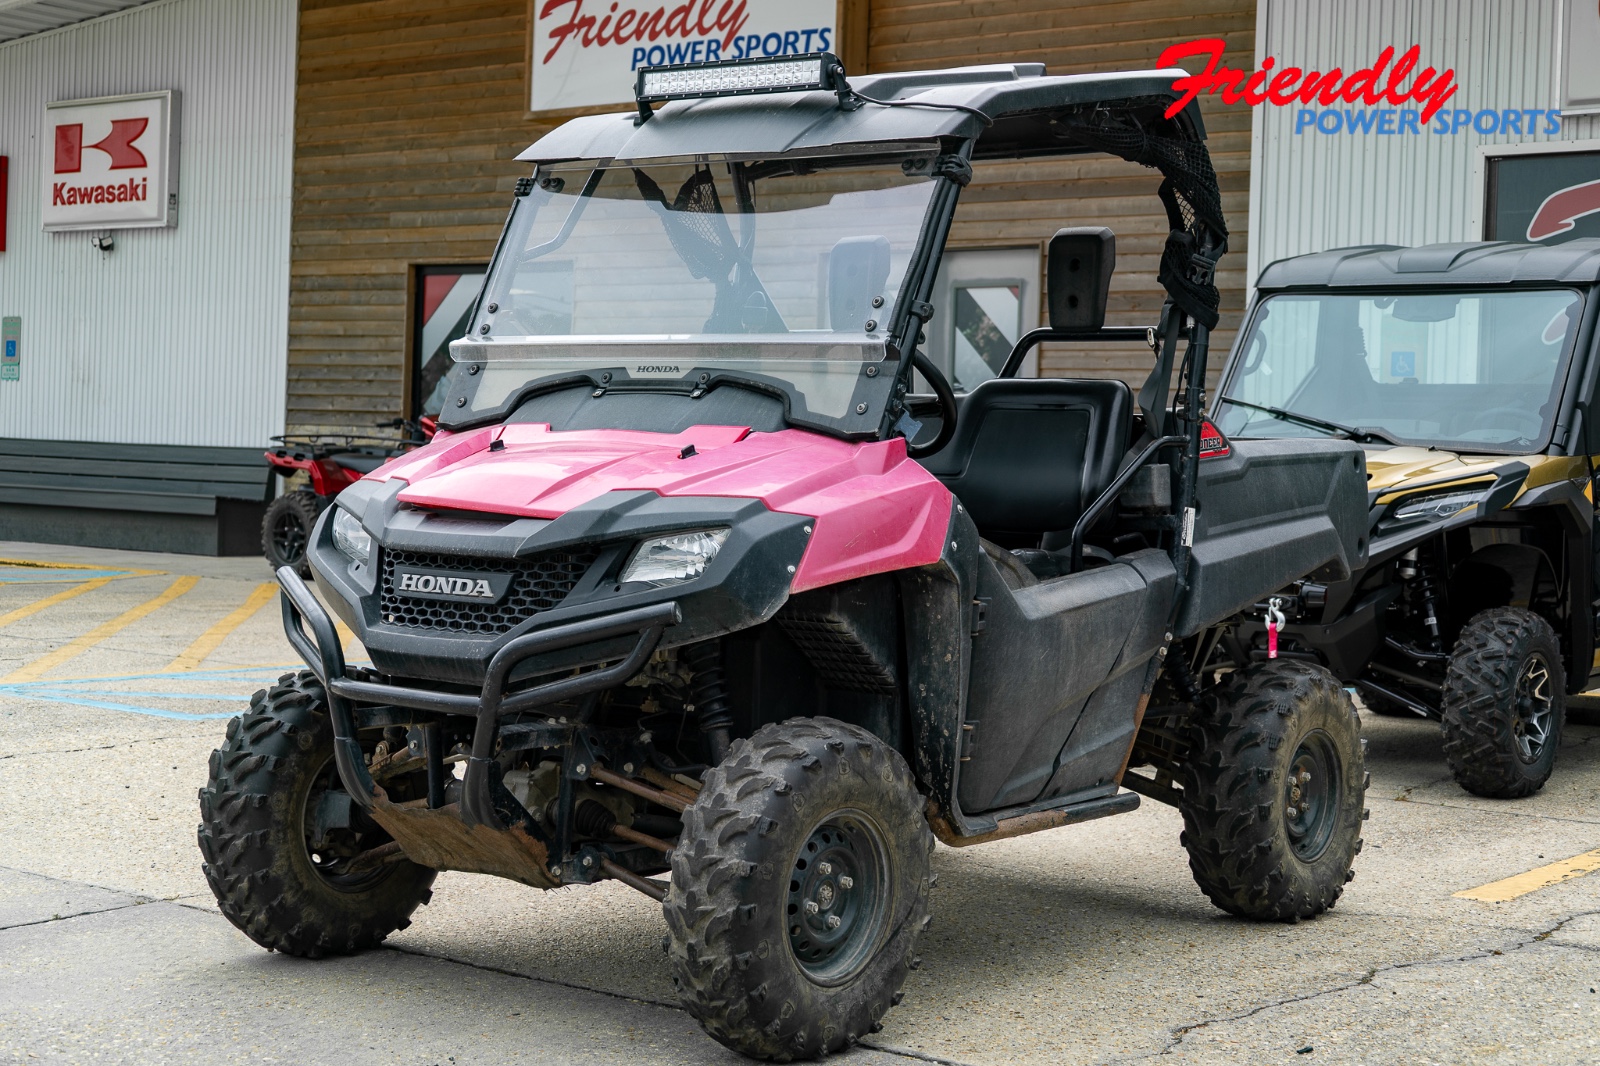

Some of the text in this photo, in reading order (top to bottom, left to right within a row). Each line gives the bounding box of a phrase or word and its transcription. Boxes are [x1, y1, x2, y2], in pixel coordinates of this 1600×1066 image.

[539, 0, 750, 65] Friendly
[631, 27, 832, 71] POWER SPORTS
[52, 177, 147, 206] Kawasaki
[636, 365, 680, 373] HONDA
[399, 573, 494, 598] HONDA
